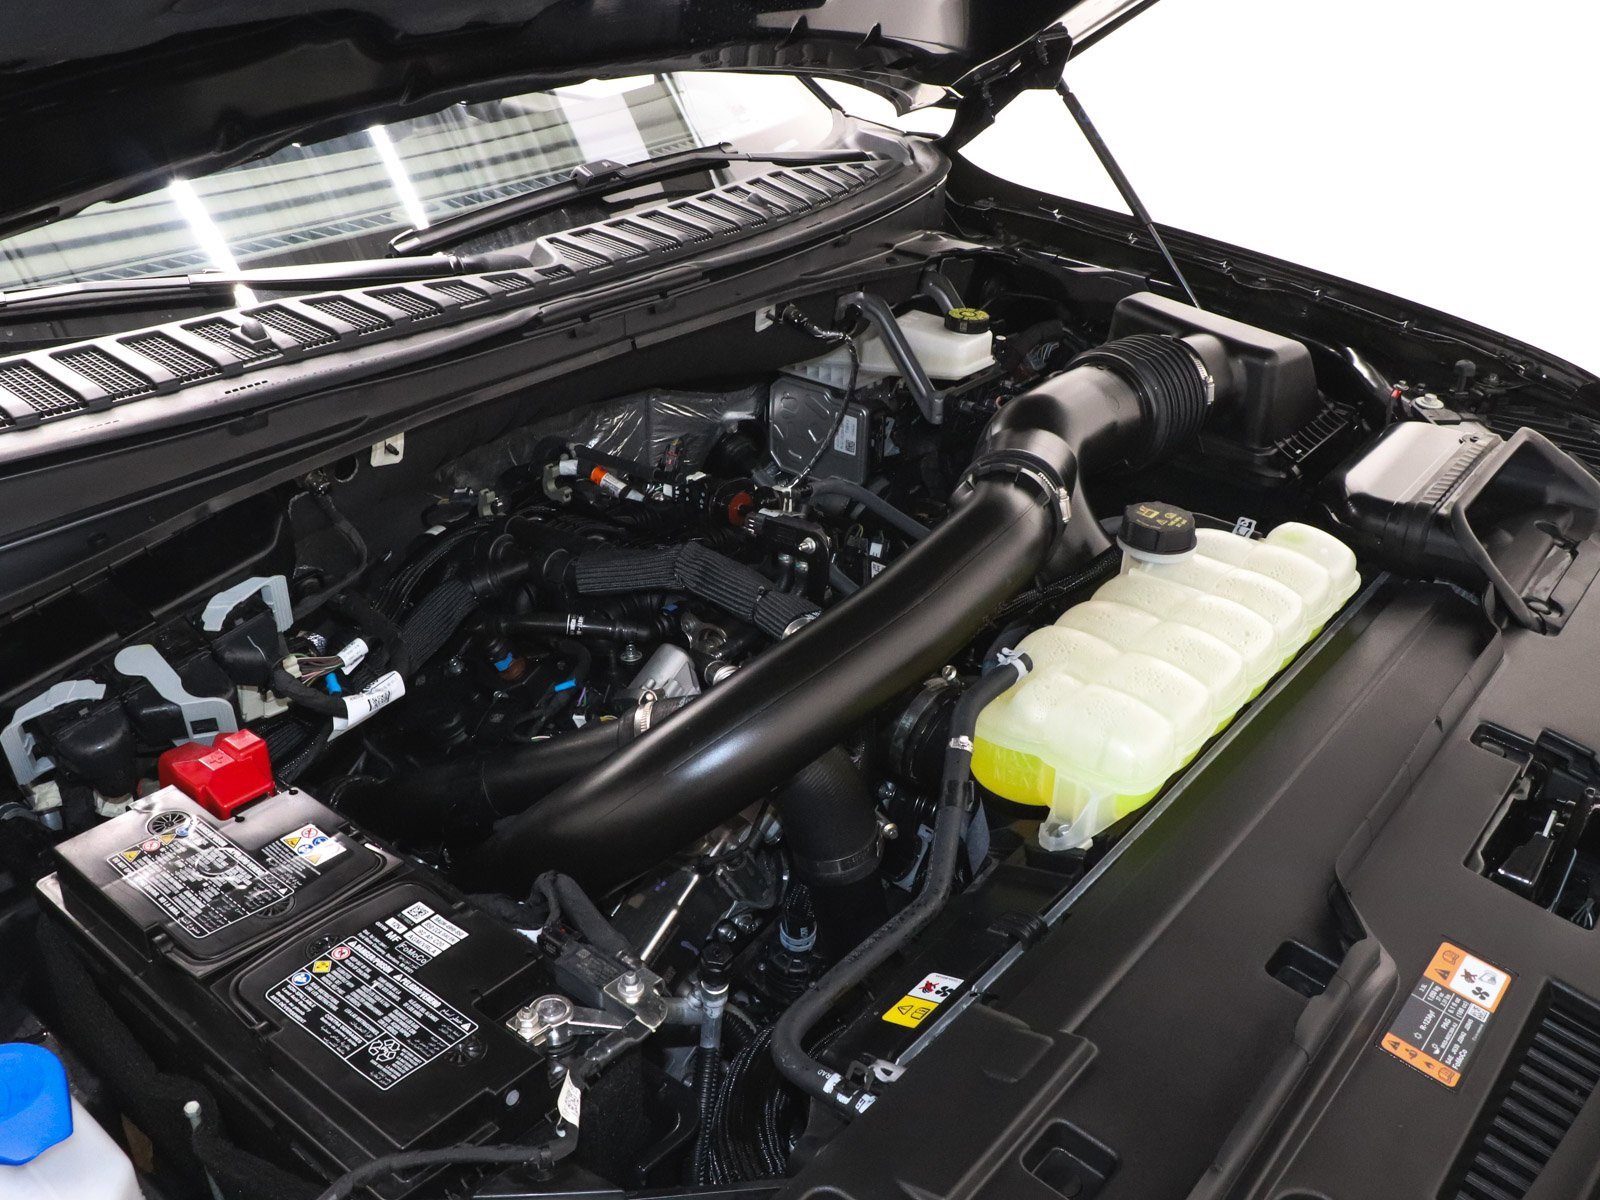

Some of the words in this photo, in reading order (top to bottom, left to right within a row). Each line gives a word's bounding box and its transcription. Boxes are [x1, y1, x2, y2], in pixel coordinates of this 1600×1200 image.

[390, 921, 402, 930] 12V
[384, 930, 403, 944] MF
[397, 942, 429, 964] FoMoCo
[1418, 1009, 1437, 1032] R-1234yf
[1440, 1016, 1452, 1030] PAG
[1451, 1047, 1468, 1070] FoMoCo
